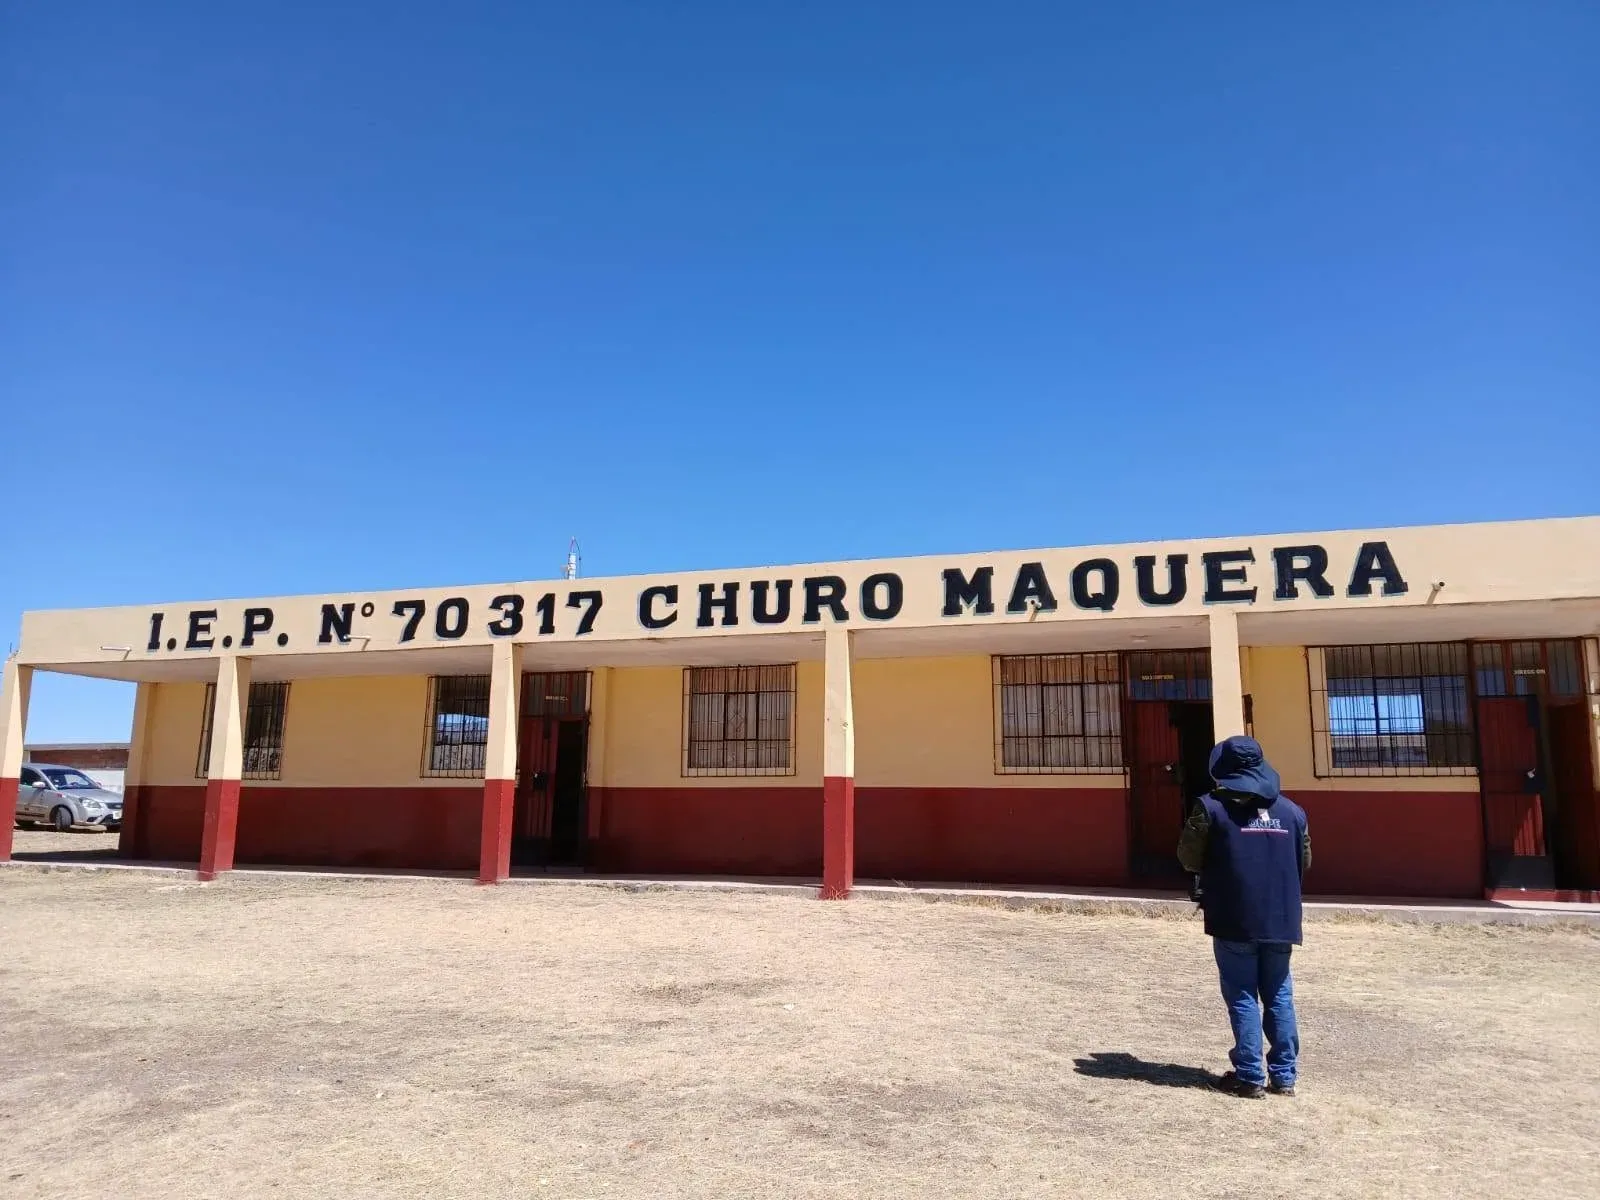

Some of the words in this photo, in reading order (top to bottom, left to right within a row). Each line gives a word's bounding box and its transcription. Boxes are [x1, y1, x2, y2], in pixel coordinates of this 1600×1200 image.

[147, 608, 289, 651] I.E.P.
[638, 572, 904, 629] CHURO
[942, 541, 1409, 616] MAQUERA
